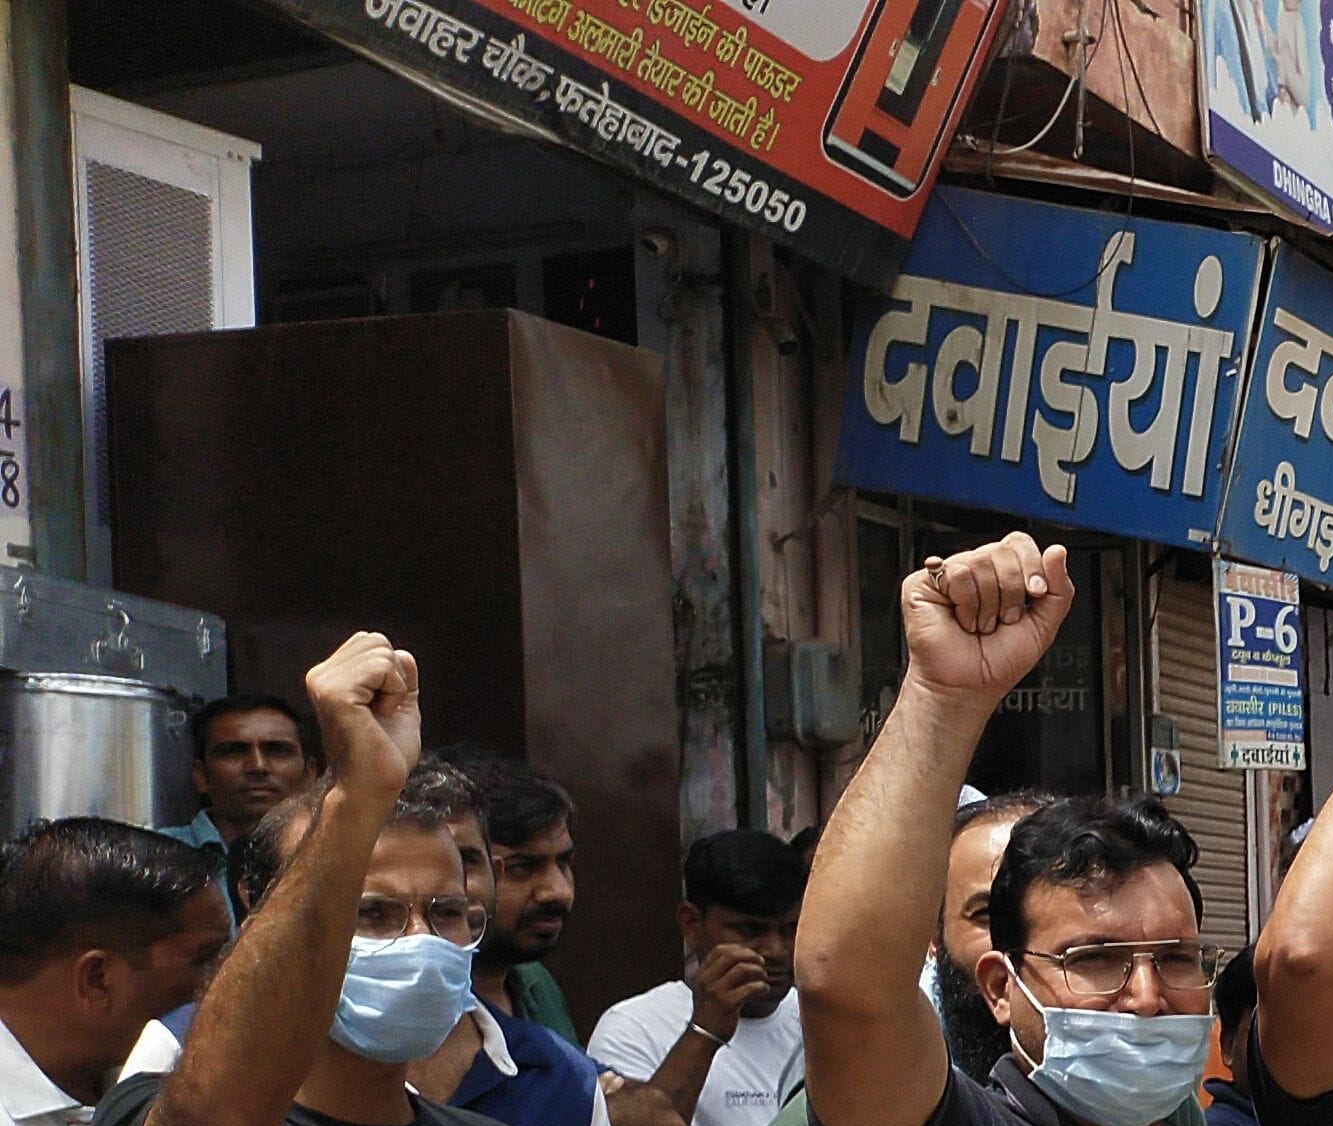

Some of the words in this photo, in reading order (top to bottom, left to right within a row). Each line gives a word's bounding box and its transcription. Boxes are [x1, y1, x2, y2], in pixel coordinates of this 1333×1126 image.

[715, 26, 748, 69] की
[681, 69, 717, 113] की
[1272, 159, 1332, 225] DHINGRA
[863, 230, 1235, 504] दवाईयां
[1225, 595, 1299, 654] P-6
[998, 677, 1090, 714] वाईयां
